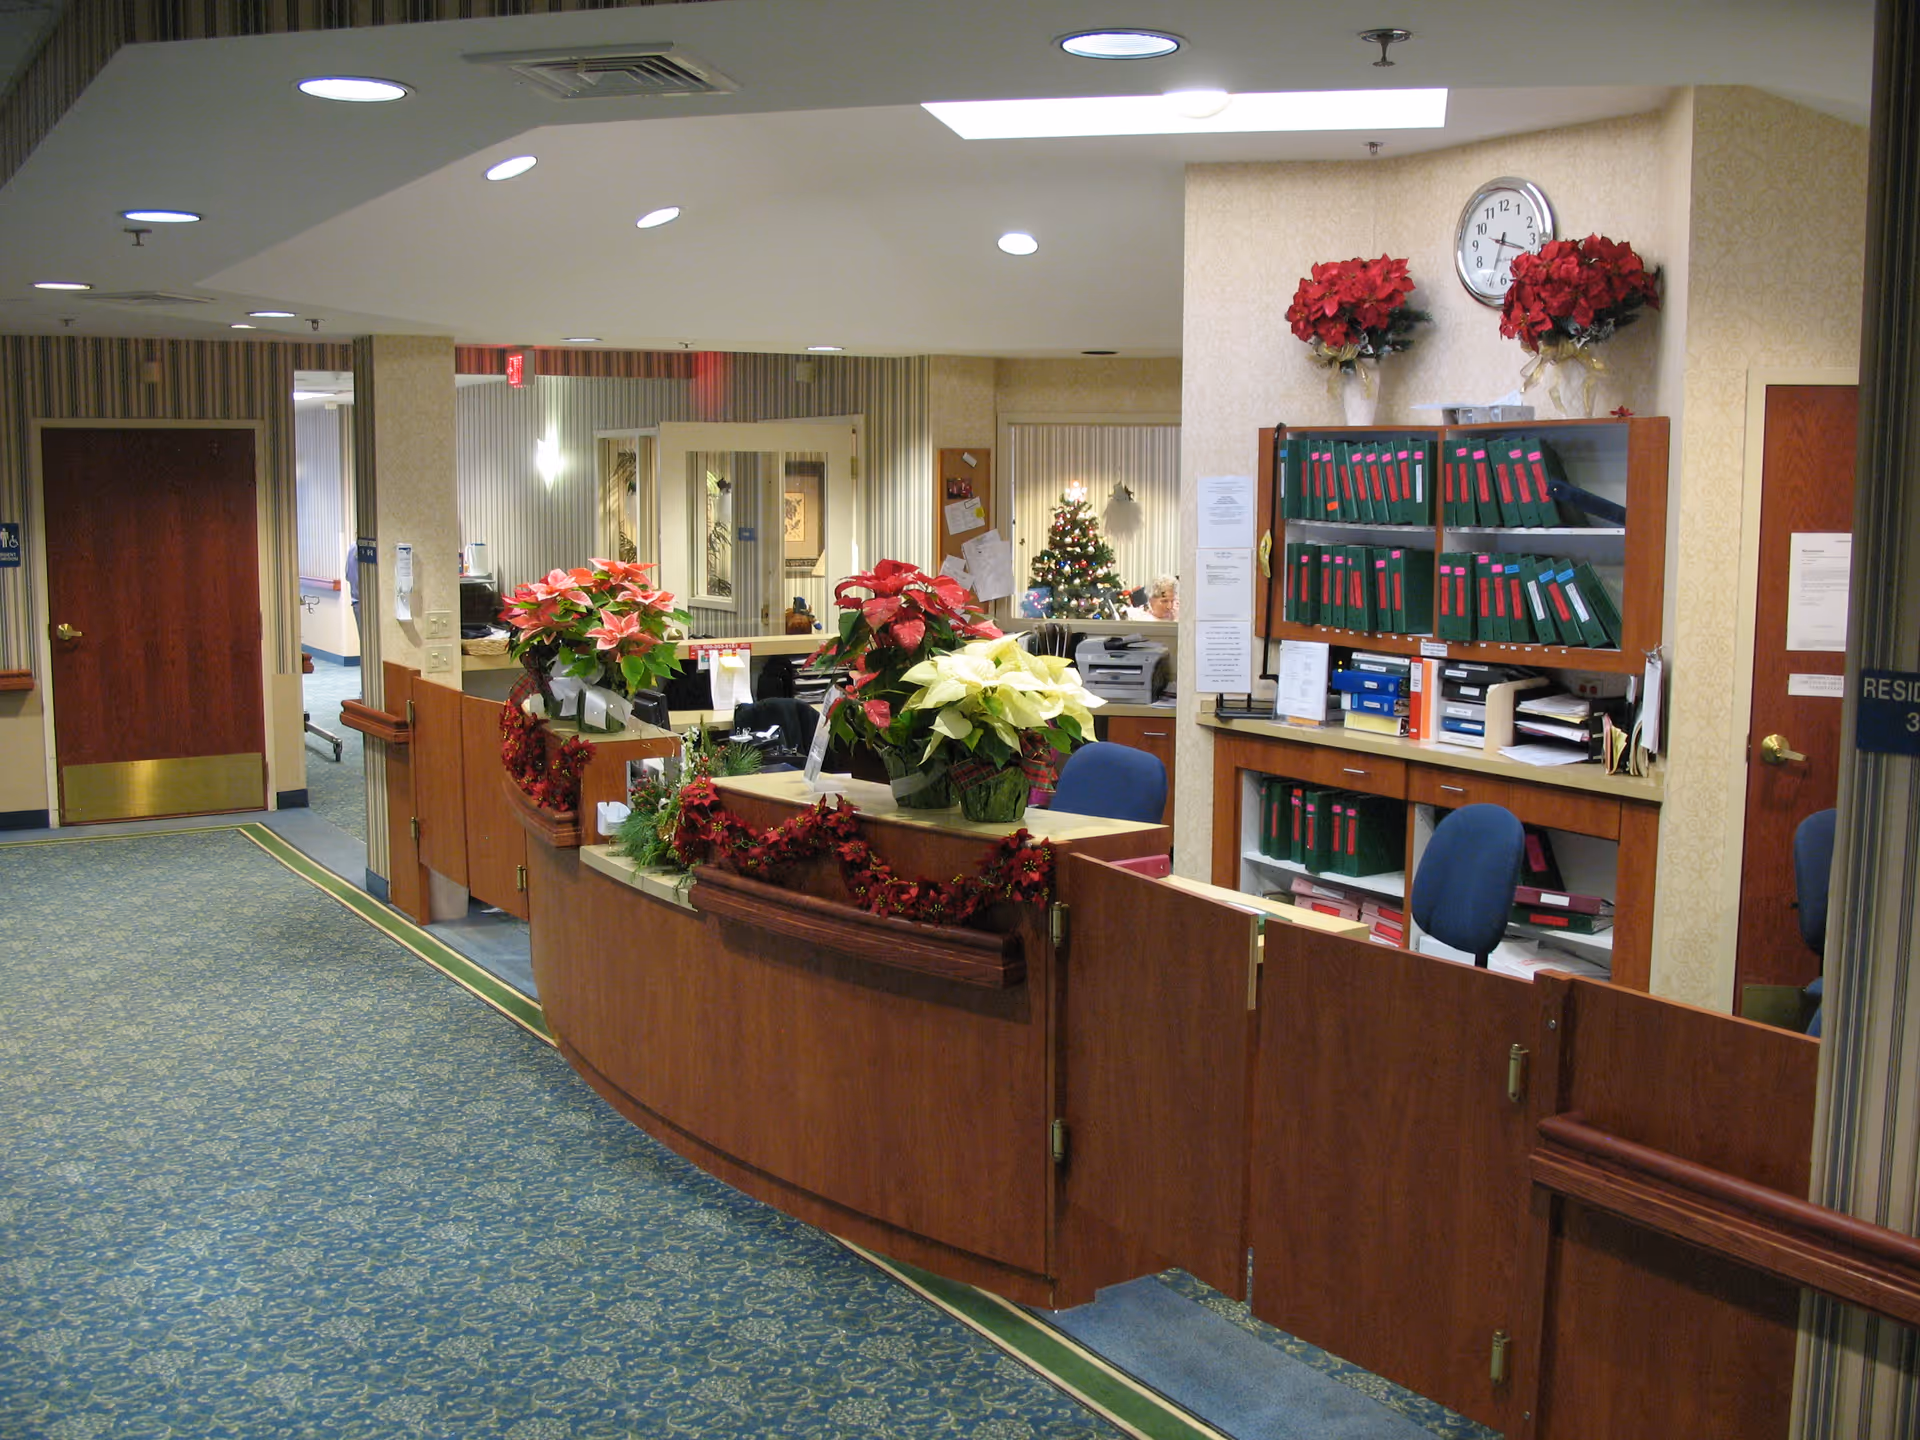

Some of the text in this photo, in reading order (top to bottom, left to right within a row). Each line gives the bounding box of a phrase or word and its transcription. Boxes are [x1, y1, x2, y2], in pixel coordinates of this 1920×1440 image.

[1498, 199, 1510, 212] 12
[1515, 203, 1521, 216] 1
[1484, 207, 1495, 220] 11
[1526, 216, 1533, 229] 2
[1476, 223, 1487, 236] 10
[1529, 232, 1536, 245] 3
[1472, 240, 1479, 252] 9
[1476, 256, 1483, 269] 8
[1500, 273, 1507, 286] 6
